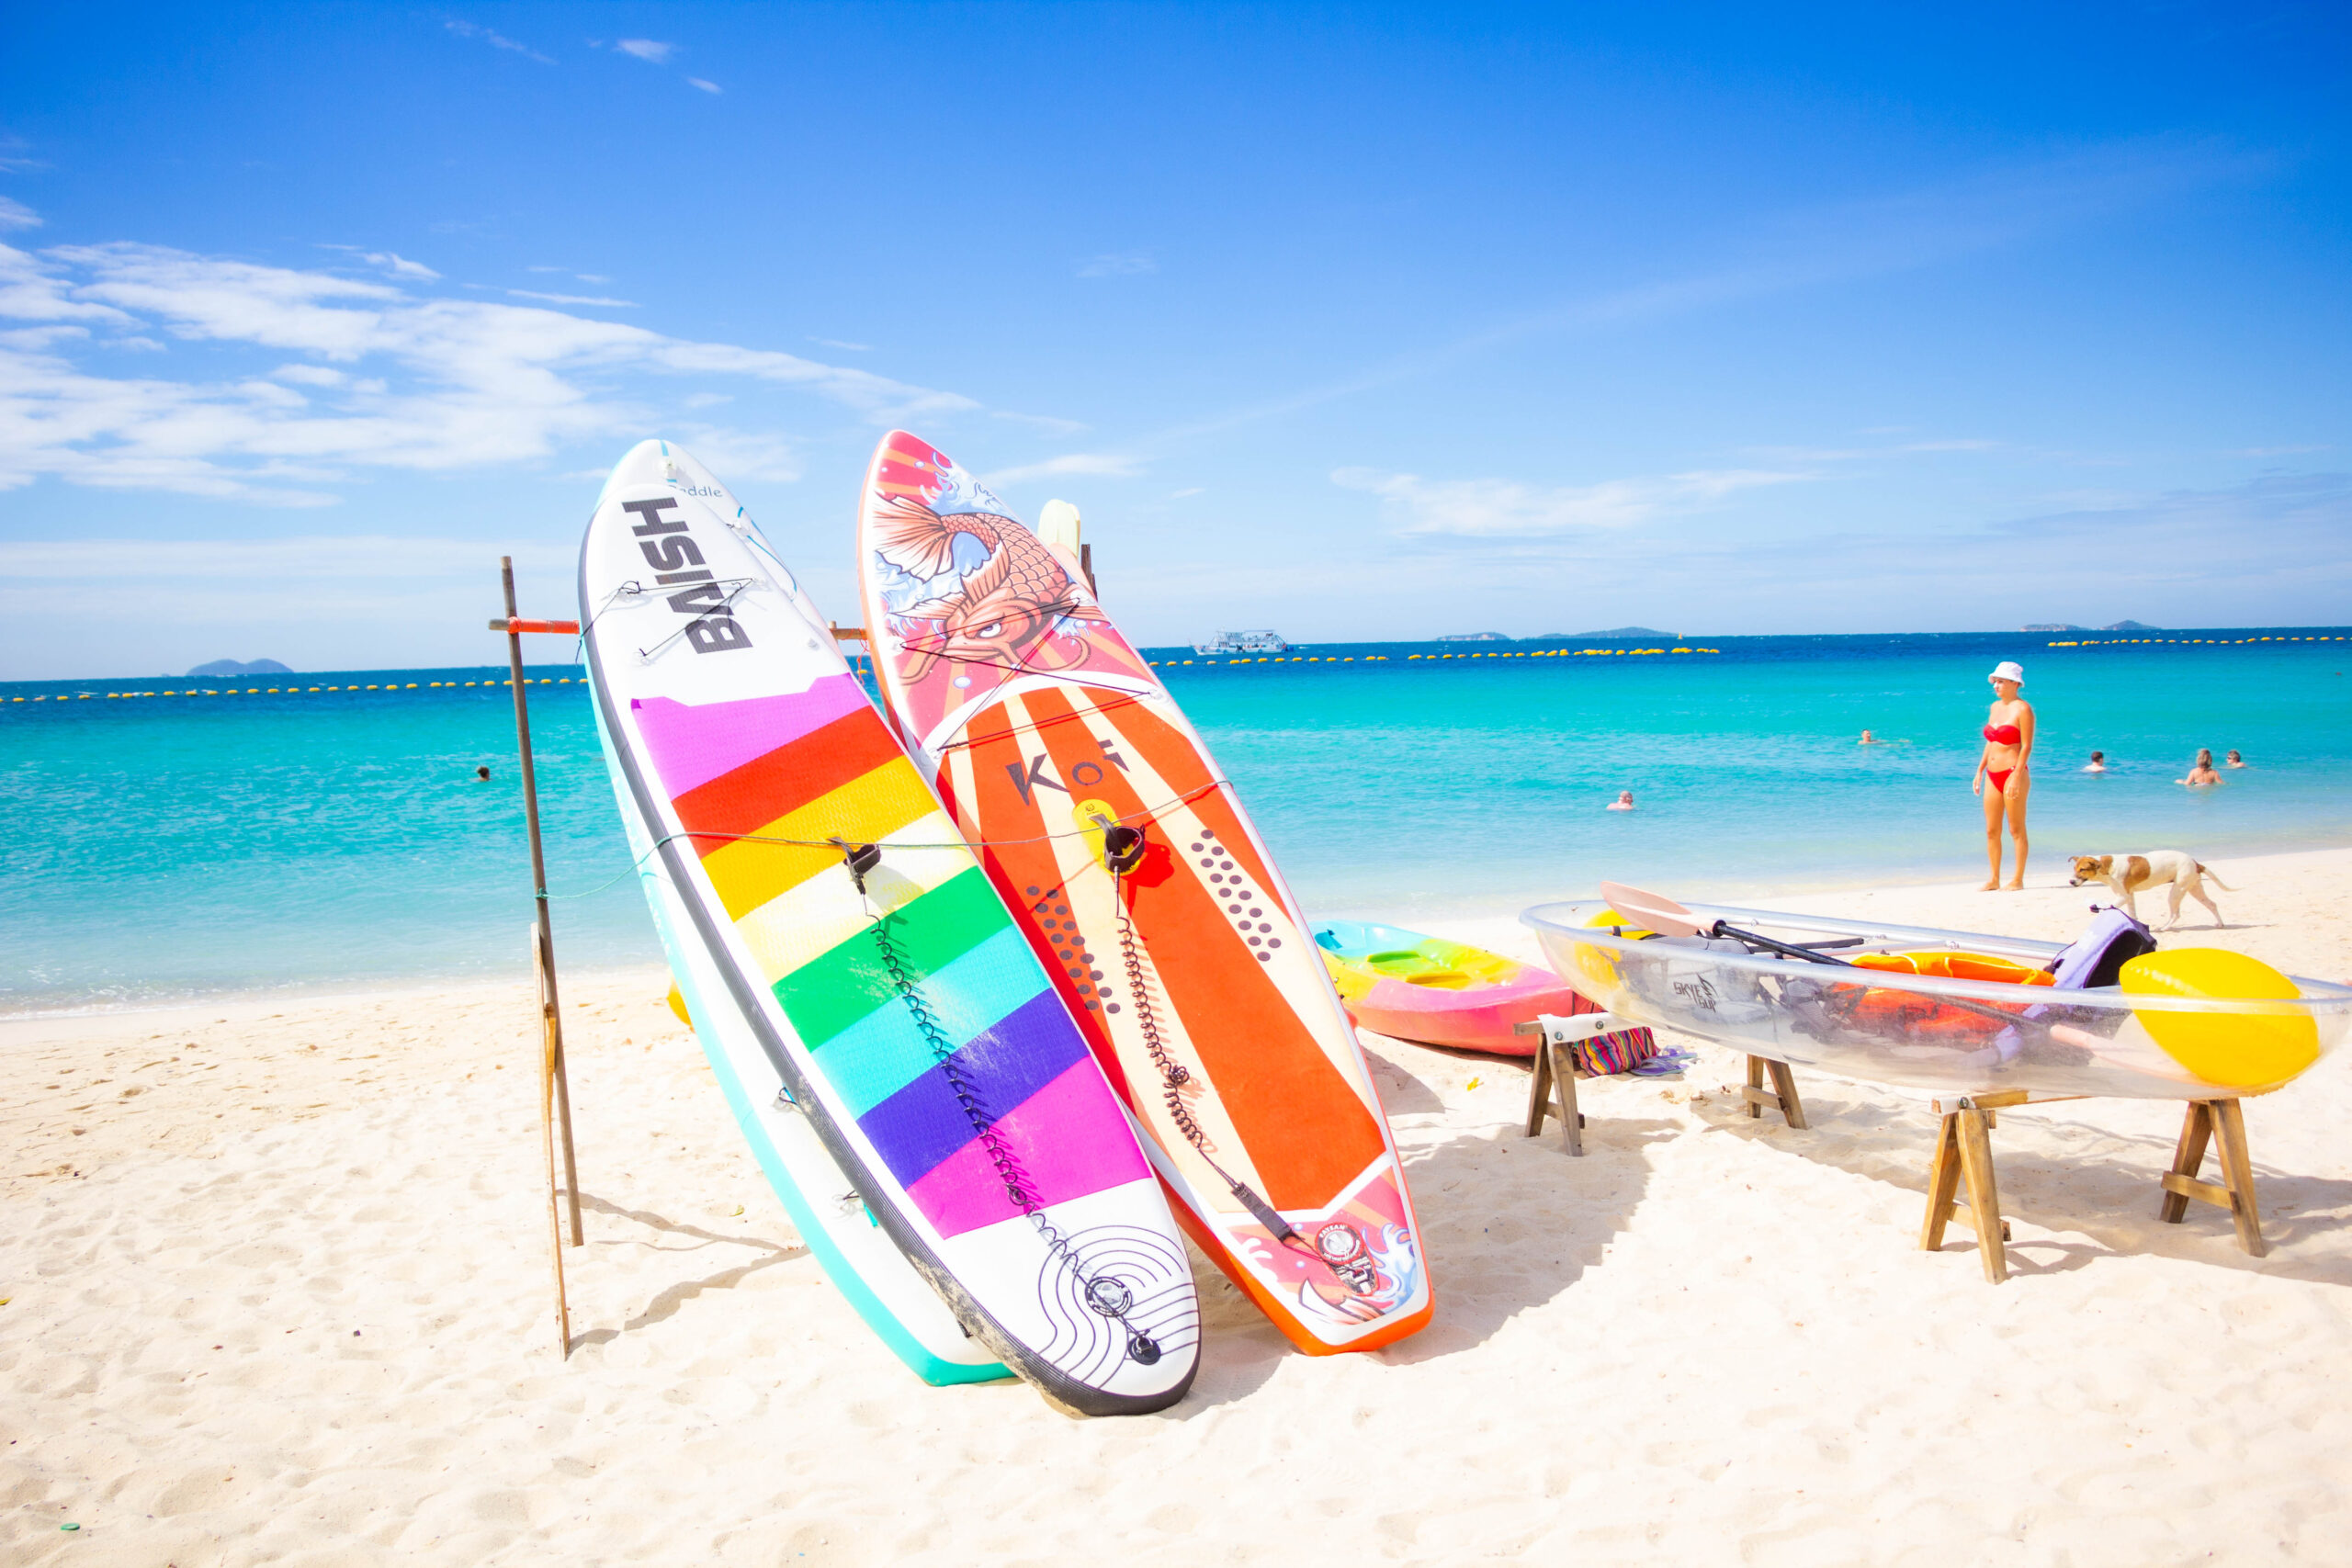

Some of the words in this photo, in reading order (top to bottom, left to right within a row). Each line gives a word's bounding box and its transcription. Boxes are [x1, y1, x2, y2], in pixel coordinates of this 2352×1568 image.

[669, 485, 723, 497] ddle
[621, 497, 753, 655] BAISH
[1673, 982, 1702, 1006] SKYE
